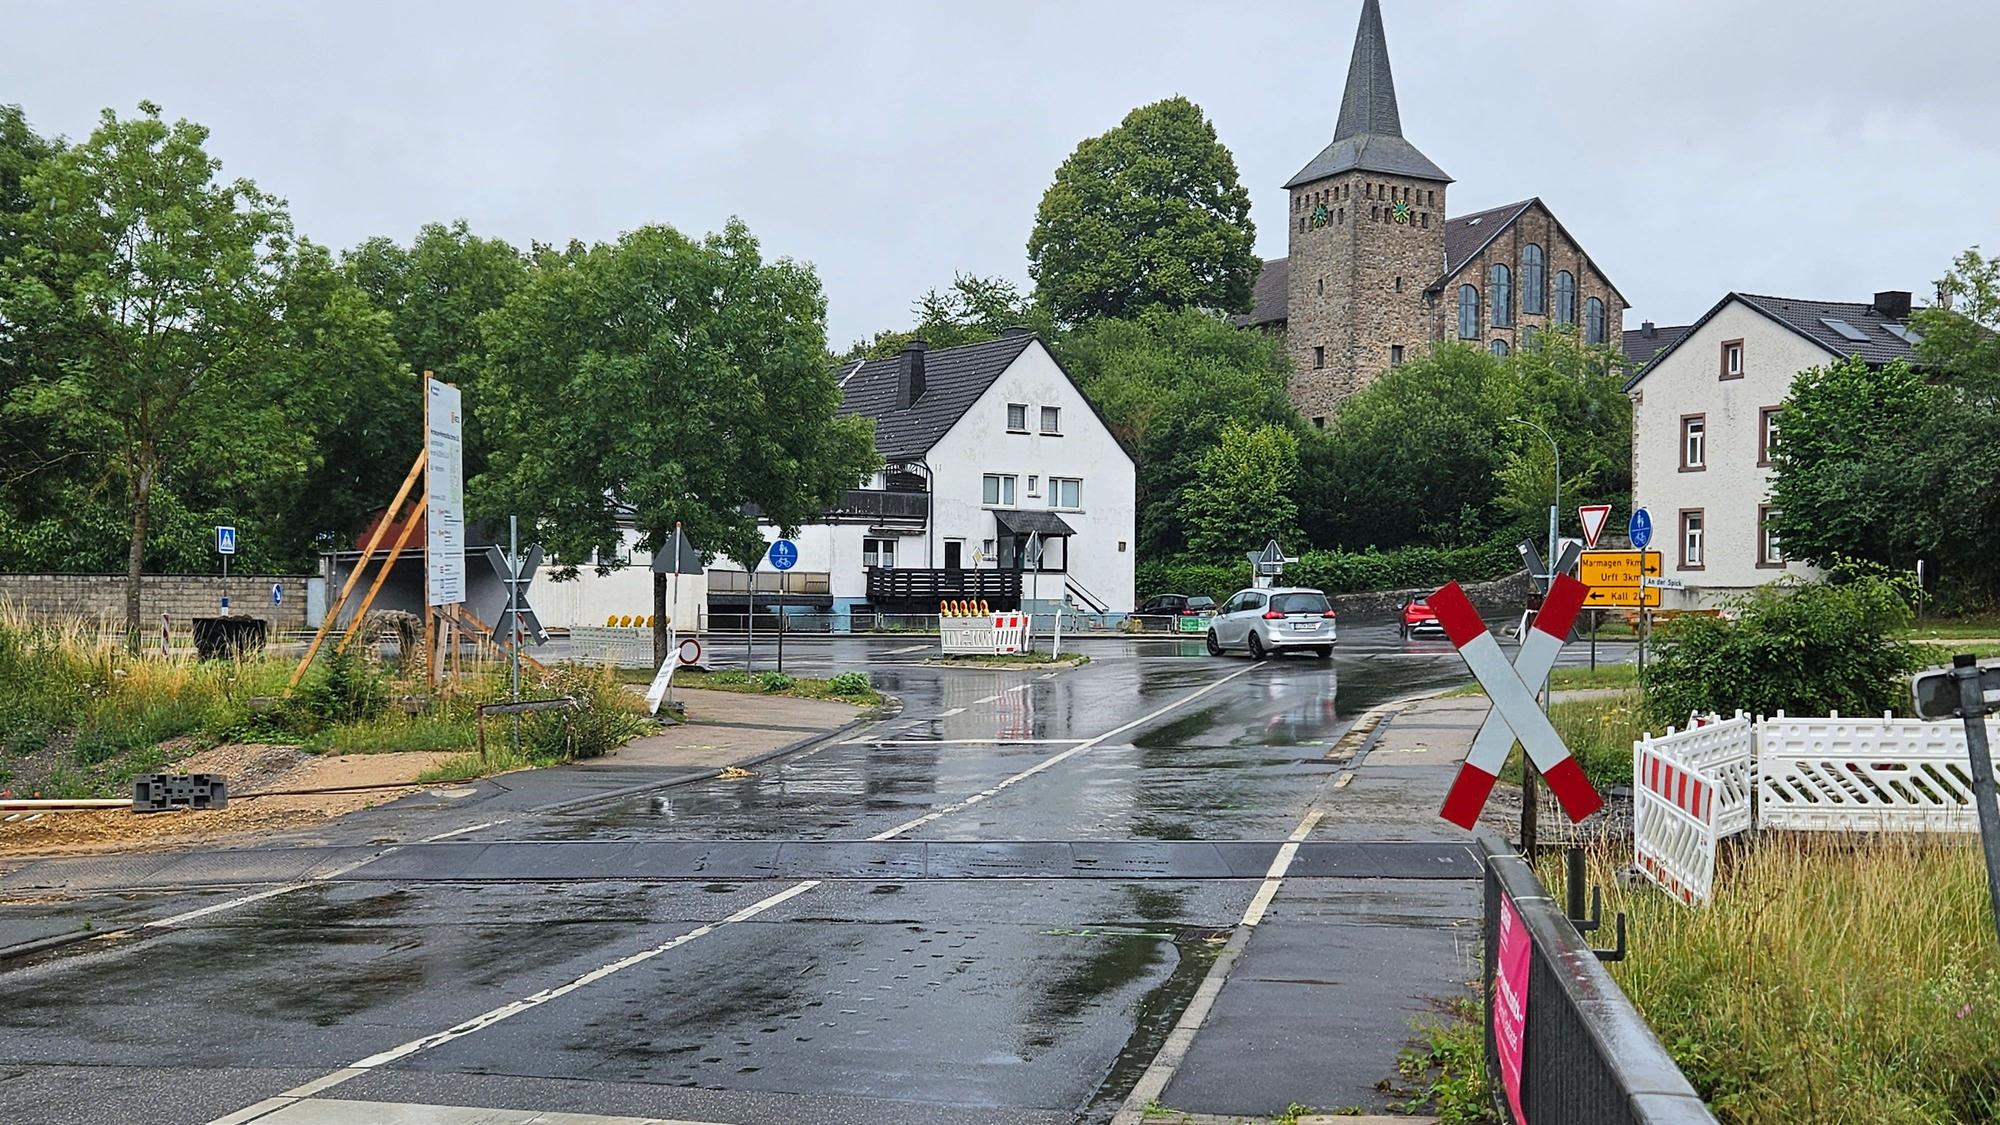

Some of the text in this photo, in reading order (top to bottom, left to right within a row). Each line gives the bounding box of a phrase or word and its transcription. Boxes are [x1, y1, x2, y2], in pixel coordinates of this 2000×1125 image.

[1583, 559, 1621, 568] Marmagen
[1601, 573, 1618, 581] Urft
[1668, 579, 1682, 587] Spick
[1611, 592, 1628, 600] Kall
